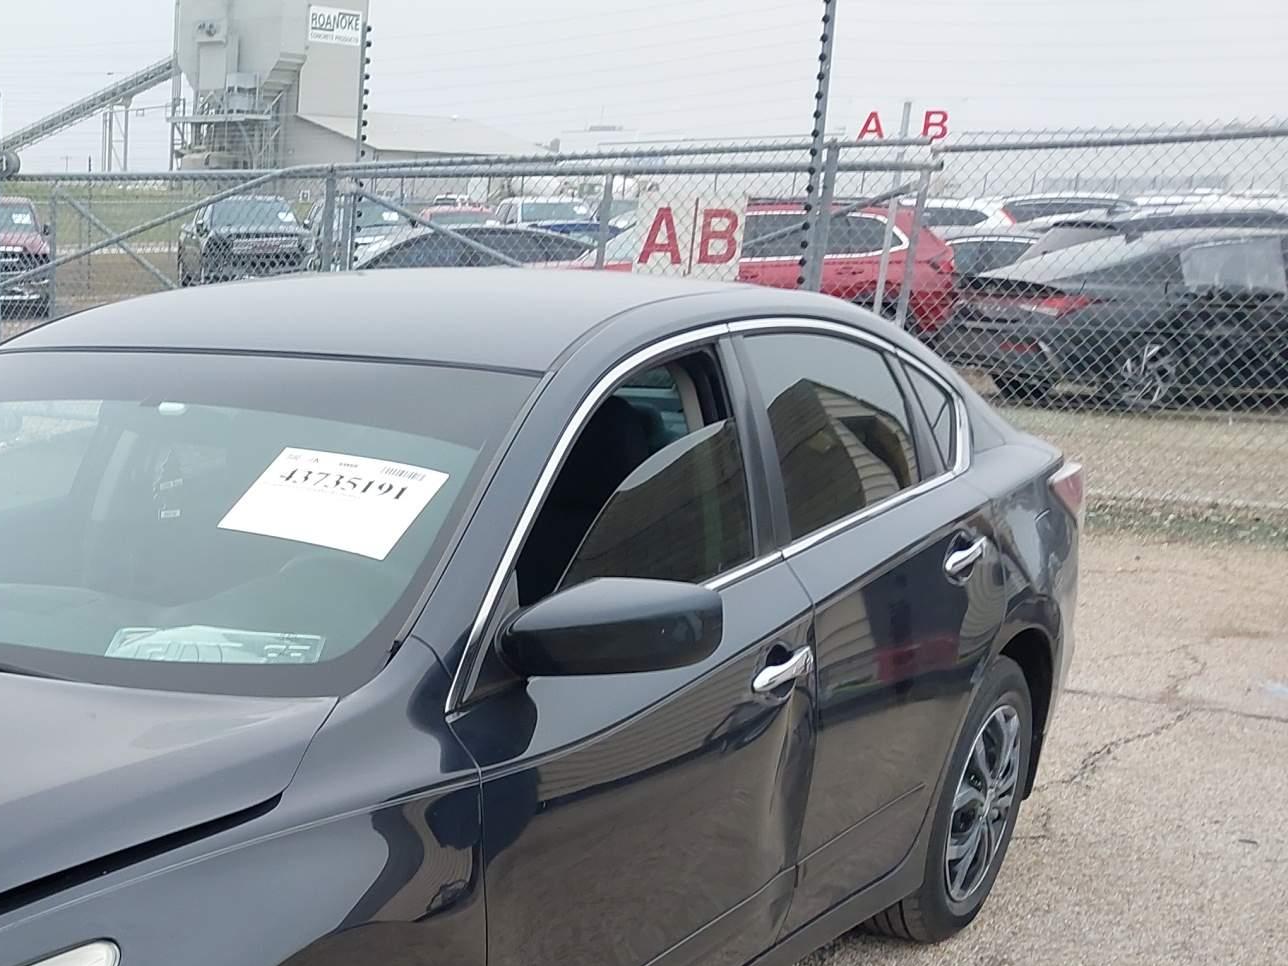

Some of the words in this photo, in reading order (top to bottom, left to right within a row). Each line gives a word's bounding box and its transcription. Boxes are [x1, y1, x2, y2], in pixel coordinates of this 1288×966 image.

[311, 12, 360, 32] ROANOKE
[856, 111, 884, 142] A
[922, 110, 948, 140] B
[637, 206, 682, 265] A
[697, 208, 740, 265] B
[279, 467, 409, 501] 43735191
